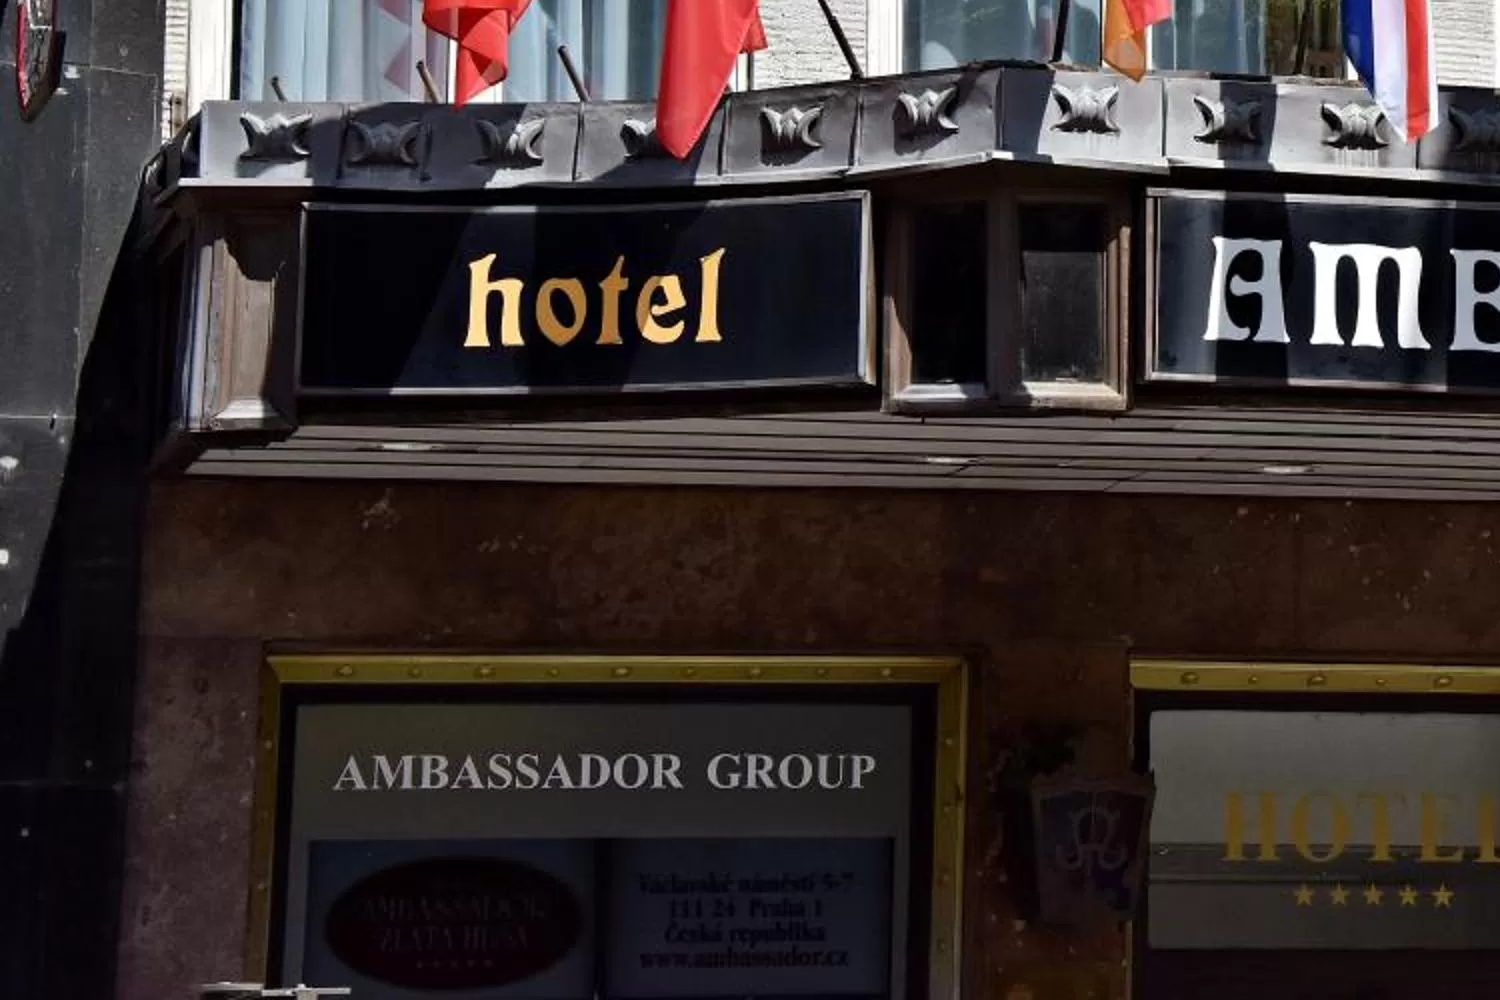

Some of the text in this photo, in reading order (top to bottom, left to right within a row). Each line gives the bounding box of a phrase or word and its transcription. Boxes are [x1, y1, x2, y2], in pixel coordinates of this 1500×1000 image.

[463, 247, 726, 346] hotel
[332, 752, 877, 792] AMBASSADOR GROUP
